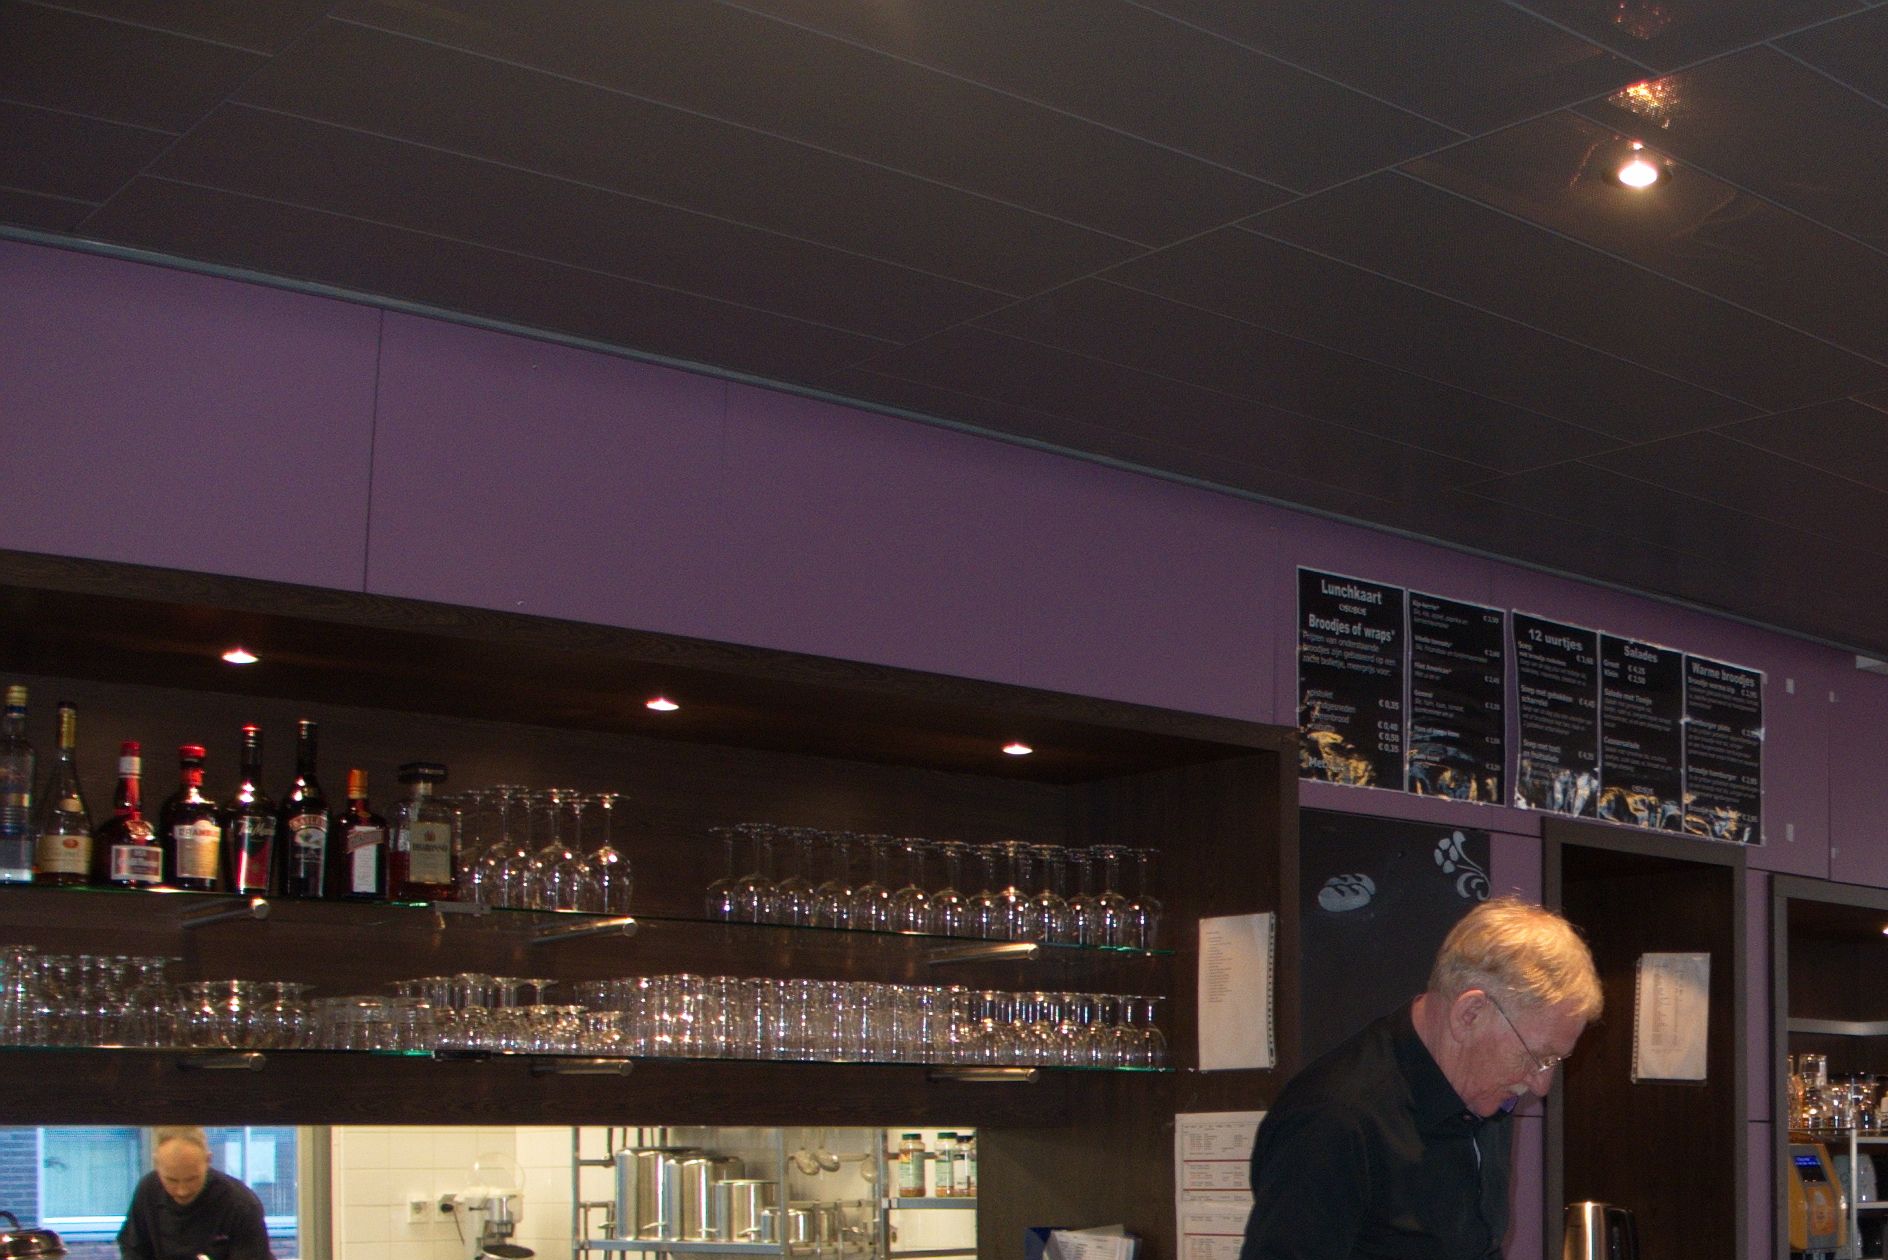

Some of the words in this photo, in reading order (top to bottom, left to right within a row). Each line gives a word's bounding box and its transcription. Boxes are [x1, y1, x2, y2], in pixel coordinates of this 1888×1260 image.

[1320, 579, 1383, 605] Lunchkaart
[1308, 613, 1351, 635] Broodjes
[1352, 622, 1363, 637] of
[1528, 628, 1543, 643] 12
[1544, 634, 1583, 651] uurtjes
[1623, 644, 1658, 663] Salades
[1691, 661, 1720, 680] Warme
[1721, 669, 1755, 688] broodjes
